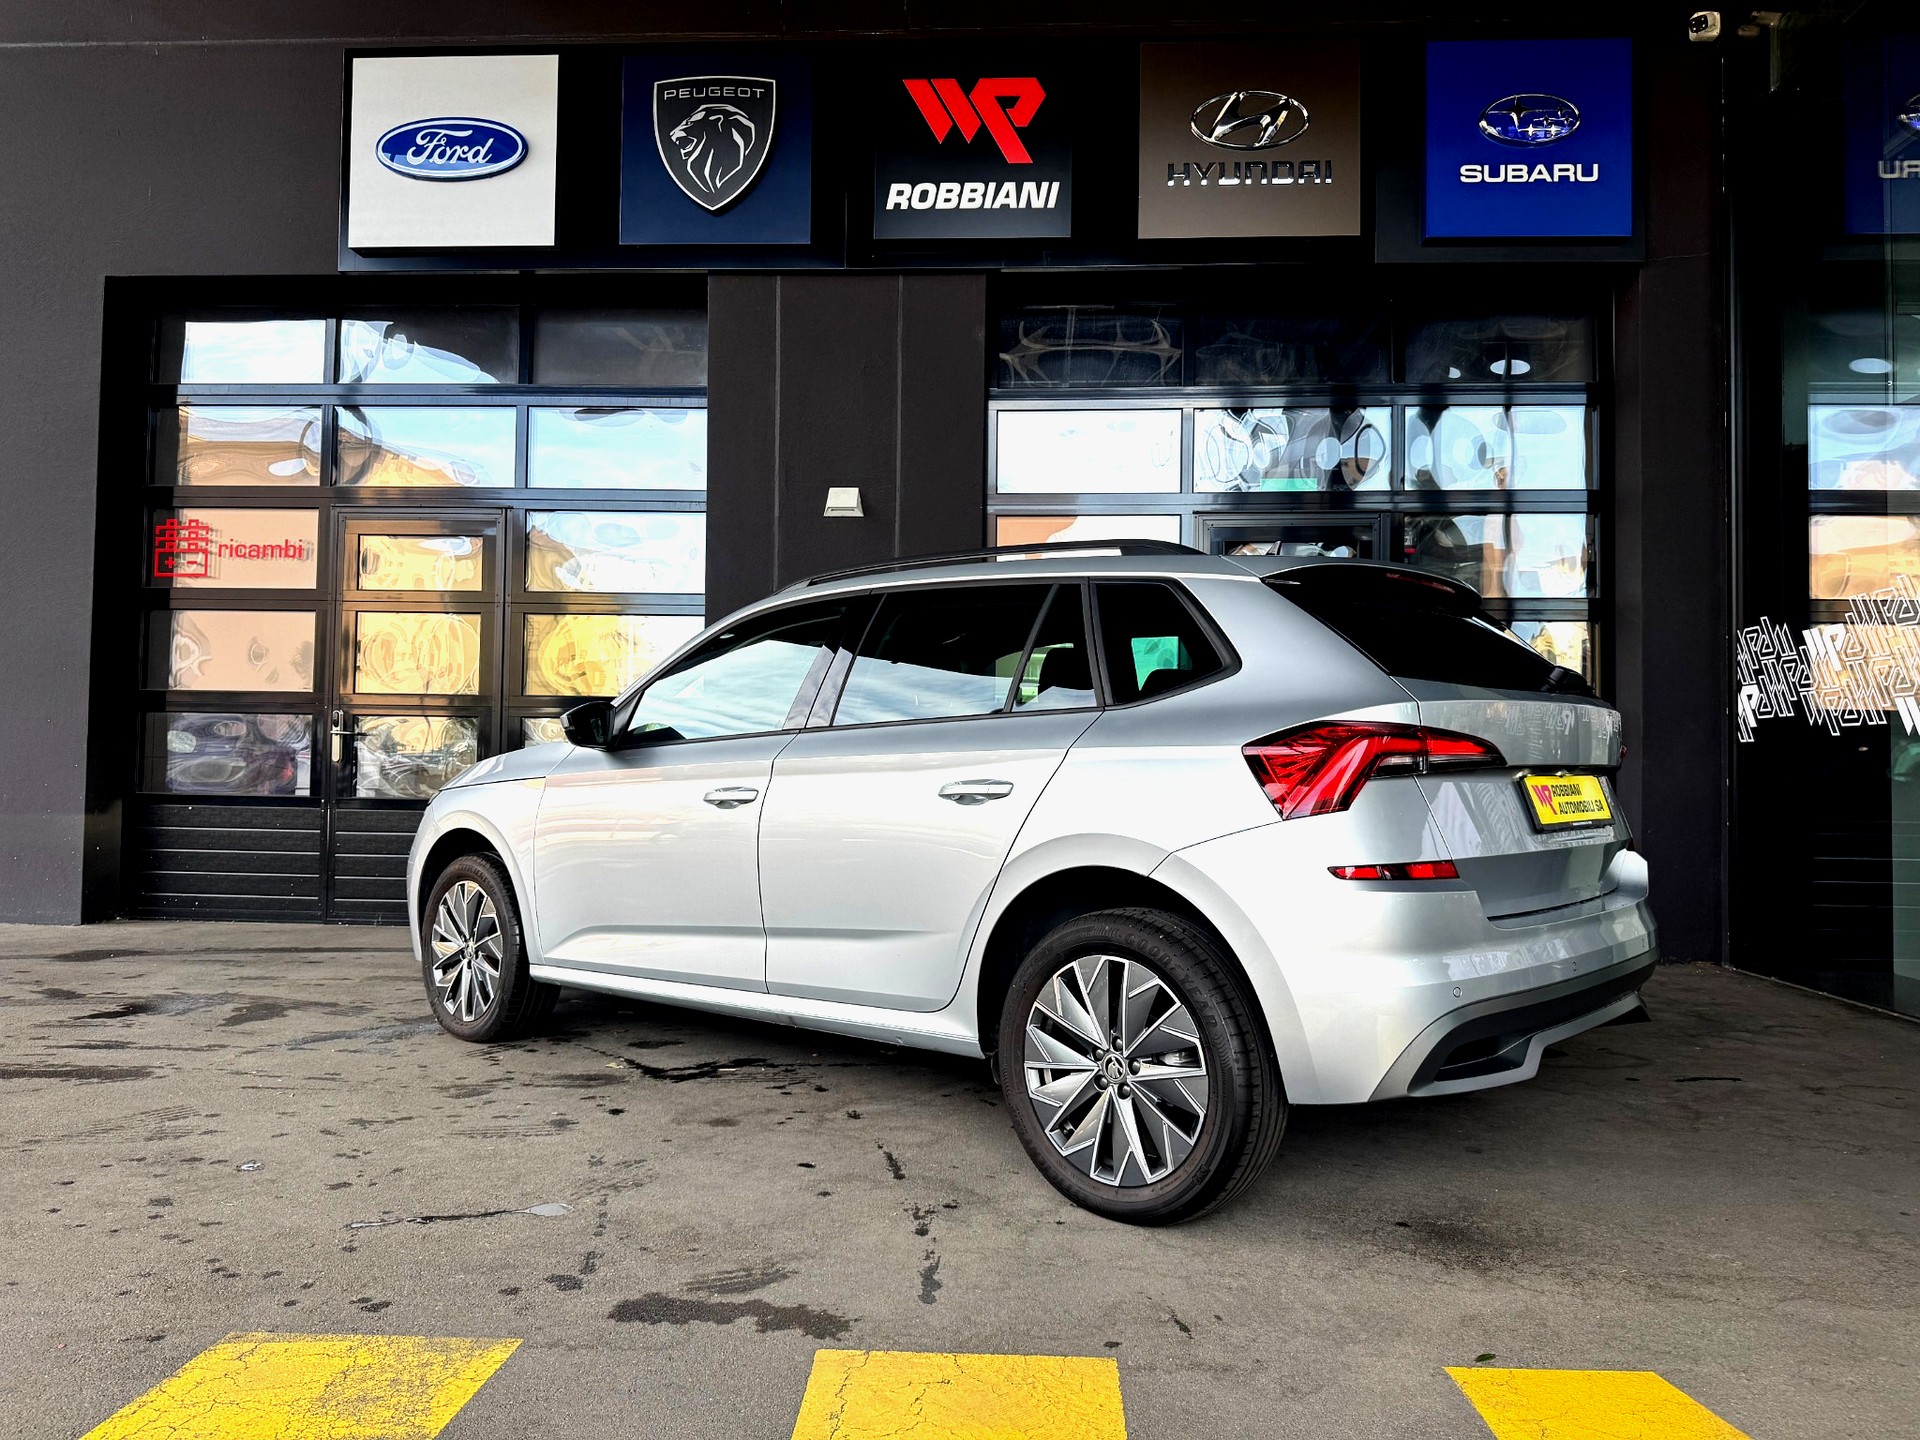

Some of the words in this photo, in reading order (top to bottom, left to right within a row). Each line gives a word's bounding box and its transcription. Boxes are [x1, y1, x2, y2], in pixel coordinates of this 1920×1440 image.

[664, 87, 766, 101] PEUGEOT
[406, 129, 493, 165] Ford
[1167, 160, 1332, 187] HYUNDAI
[1460, 163, 1599, 183] SUBARU
[886, 181, 1060, 210] ROBBIANI
[218, 538, 303, 559] ricambi
[1551, 783, 1582, 797] ROBBIANI
[1558, 800, 1596, 815] AUTOMOBILI
[1594, 799, 1605, 812] SA
